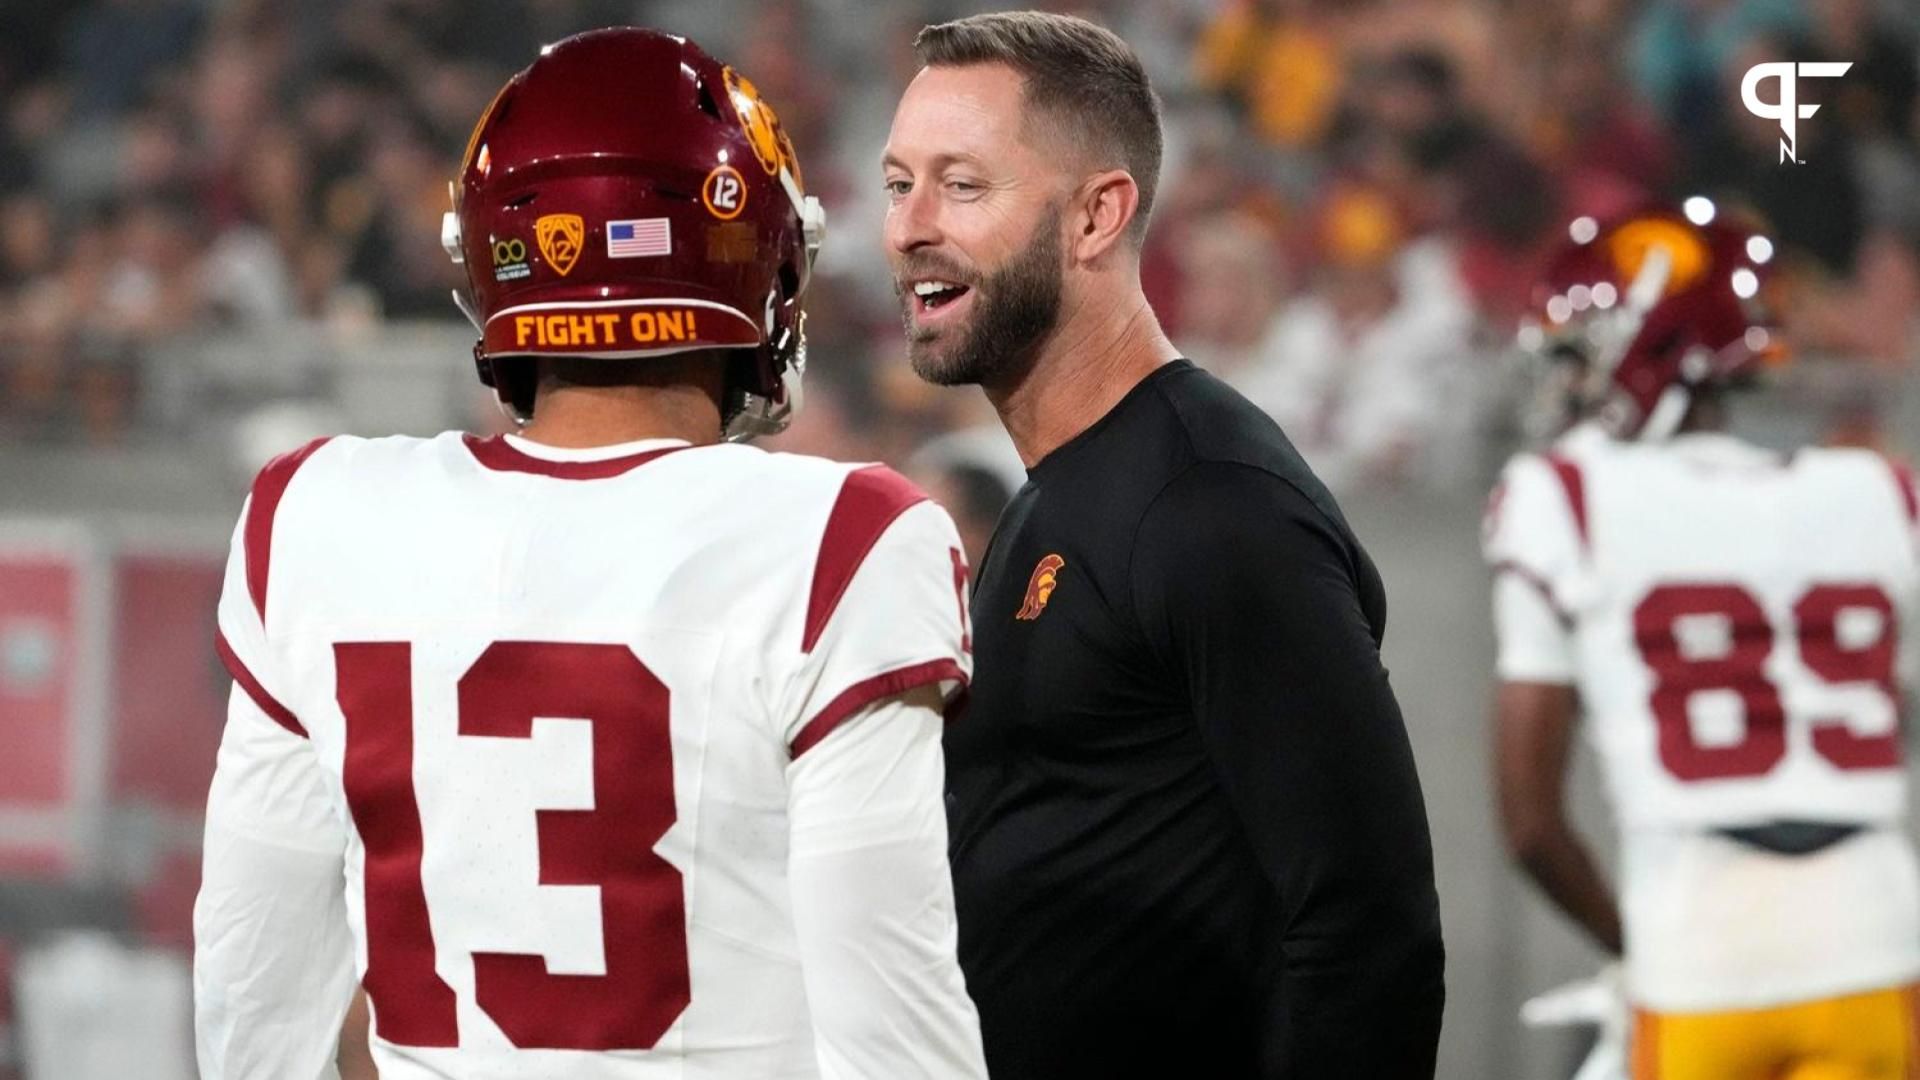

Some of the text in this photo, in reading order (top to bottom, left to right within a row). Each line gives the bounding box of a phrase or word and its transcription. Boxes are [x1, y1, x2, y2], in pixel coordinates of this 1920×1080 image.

[713, 176, 739, 209] 12
[490, 234, 526, 266] 100
[540, 216, 581, 250] PAC
[551, 241, 572, 261] 12
[516, 310, 697, 346] FIGHT ON!
[1632, 583, 1902, 782] 89
[333, 640, 691, 1050] 13
